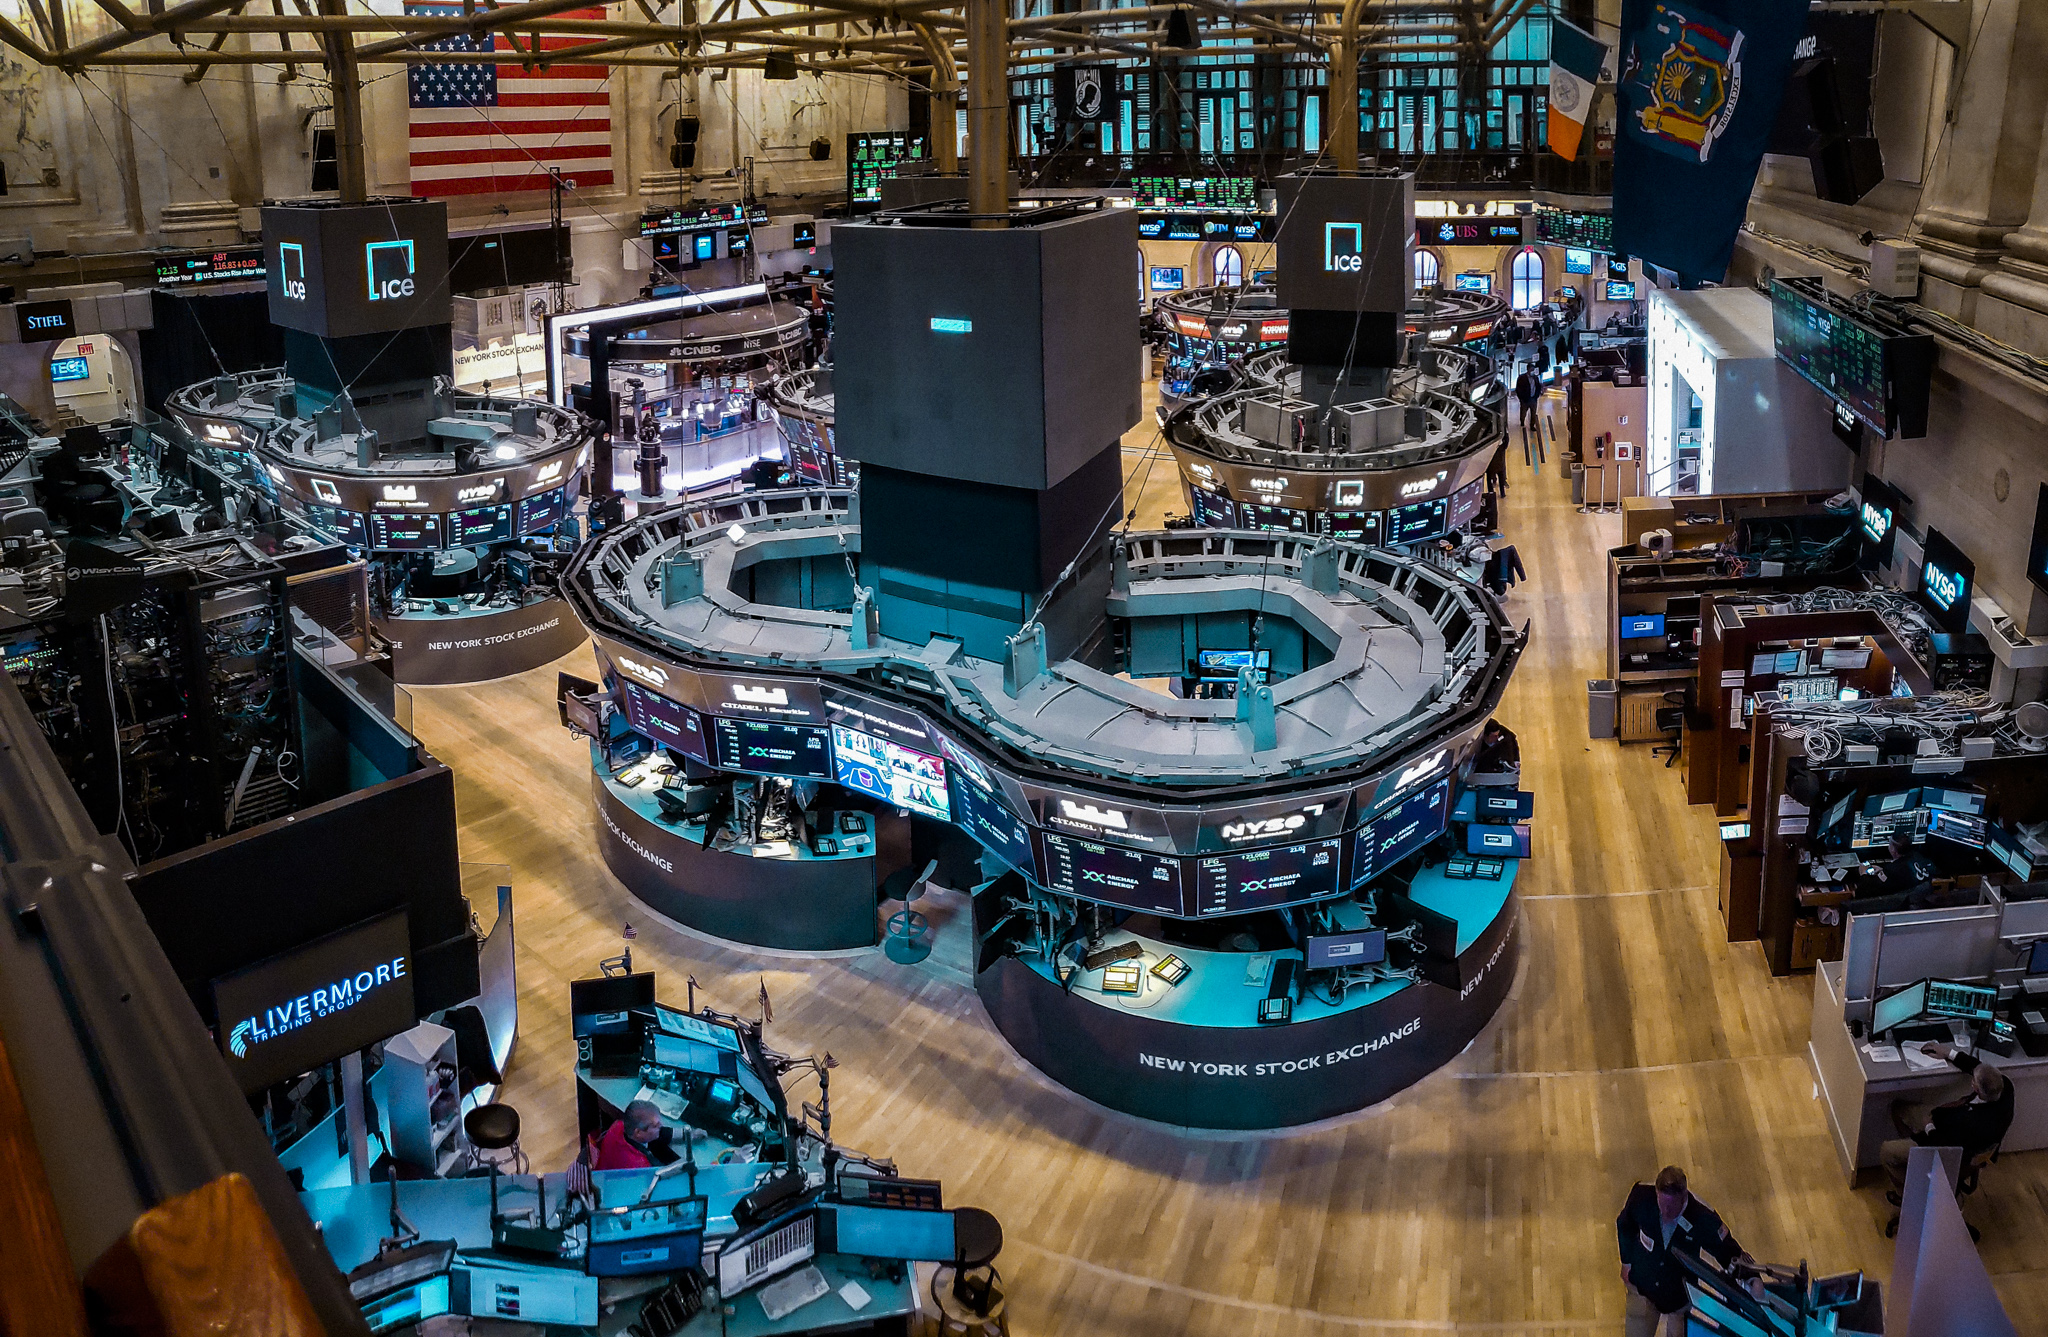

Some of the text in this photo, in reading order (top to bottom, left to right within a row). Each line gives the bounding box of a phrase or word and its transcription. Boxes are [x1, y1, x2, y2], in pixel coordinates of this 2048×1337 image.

[1456, 225, 1478, 238] UBS
[213, 253, 227, 261] ABT
[27, 315, 67, 329] STIFEL
[785, 327, 802, 340] CNBC
[683, 344, 722, 355] CNBC
[743, 339, 761, 348] NYSE
[455, 343, 545, 365] NEW YORK STOCK EXCHAN
[51, 361, 86, 375] TECH
[428, 617, 560, 650] NEW YORK STOCK EXCHANGE
[621, 831, 673, 873] EXCHANGE
[1106, 874, 1139, 885] ARCHAEA
[1268, 872, 1301, 883] ARCHAEA
[1268, 879, 1296, 889] ENERGY
[1107, 880, 1135, 889] ENERGY
[1460, 968, 1484, 1001] NEW
[251, 956, 406, 1037] LIVERMORE
[254, 994, 363, 1044] TRADING GROUP
[1140, 1016, 1422, 1077] NEW YORK STOCK EXCHANGE
